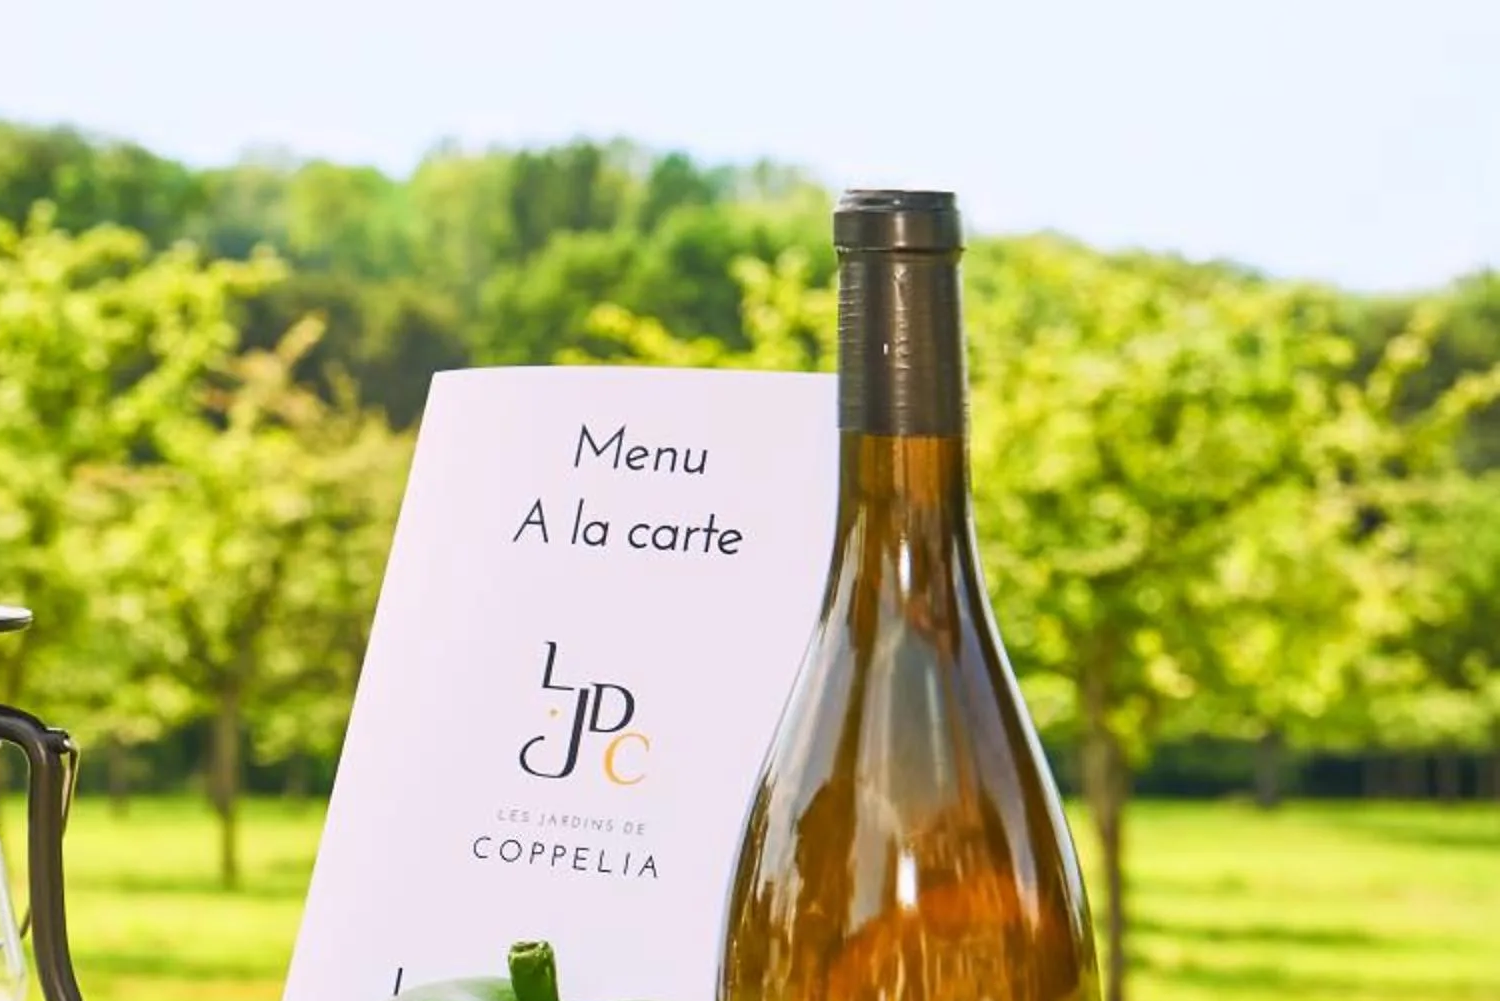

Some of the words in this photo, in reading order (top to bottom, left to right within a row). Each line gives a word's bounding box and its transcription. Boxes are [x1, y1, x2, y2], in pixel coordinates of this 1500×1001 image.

[573, 424, 708, 475] Menu
[512, 498, 549, 543] A
[571, 498, 610, 546] la
[627, 513, 743, 555] carte
[497, 808, 531, 824] LES
[537, 813, 614, 832] JARDINS
[622, 821, 647, 837] DE
[472, 835, 659, 879] COPPELIA
